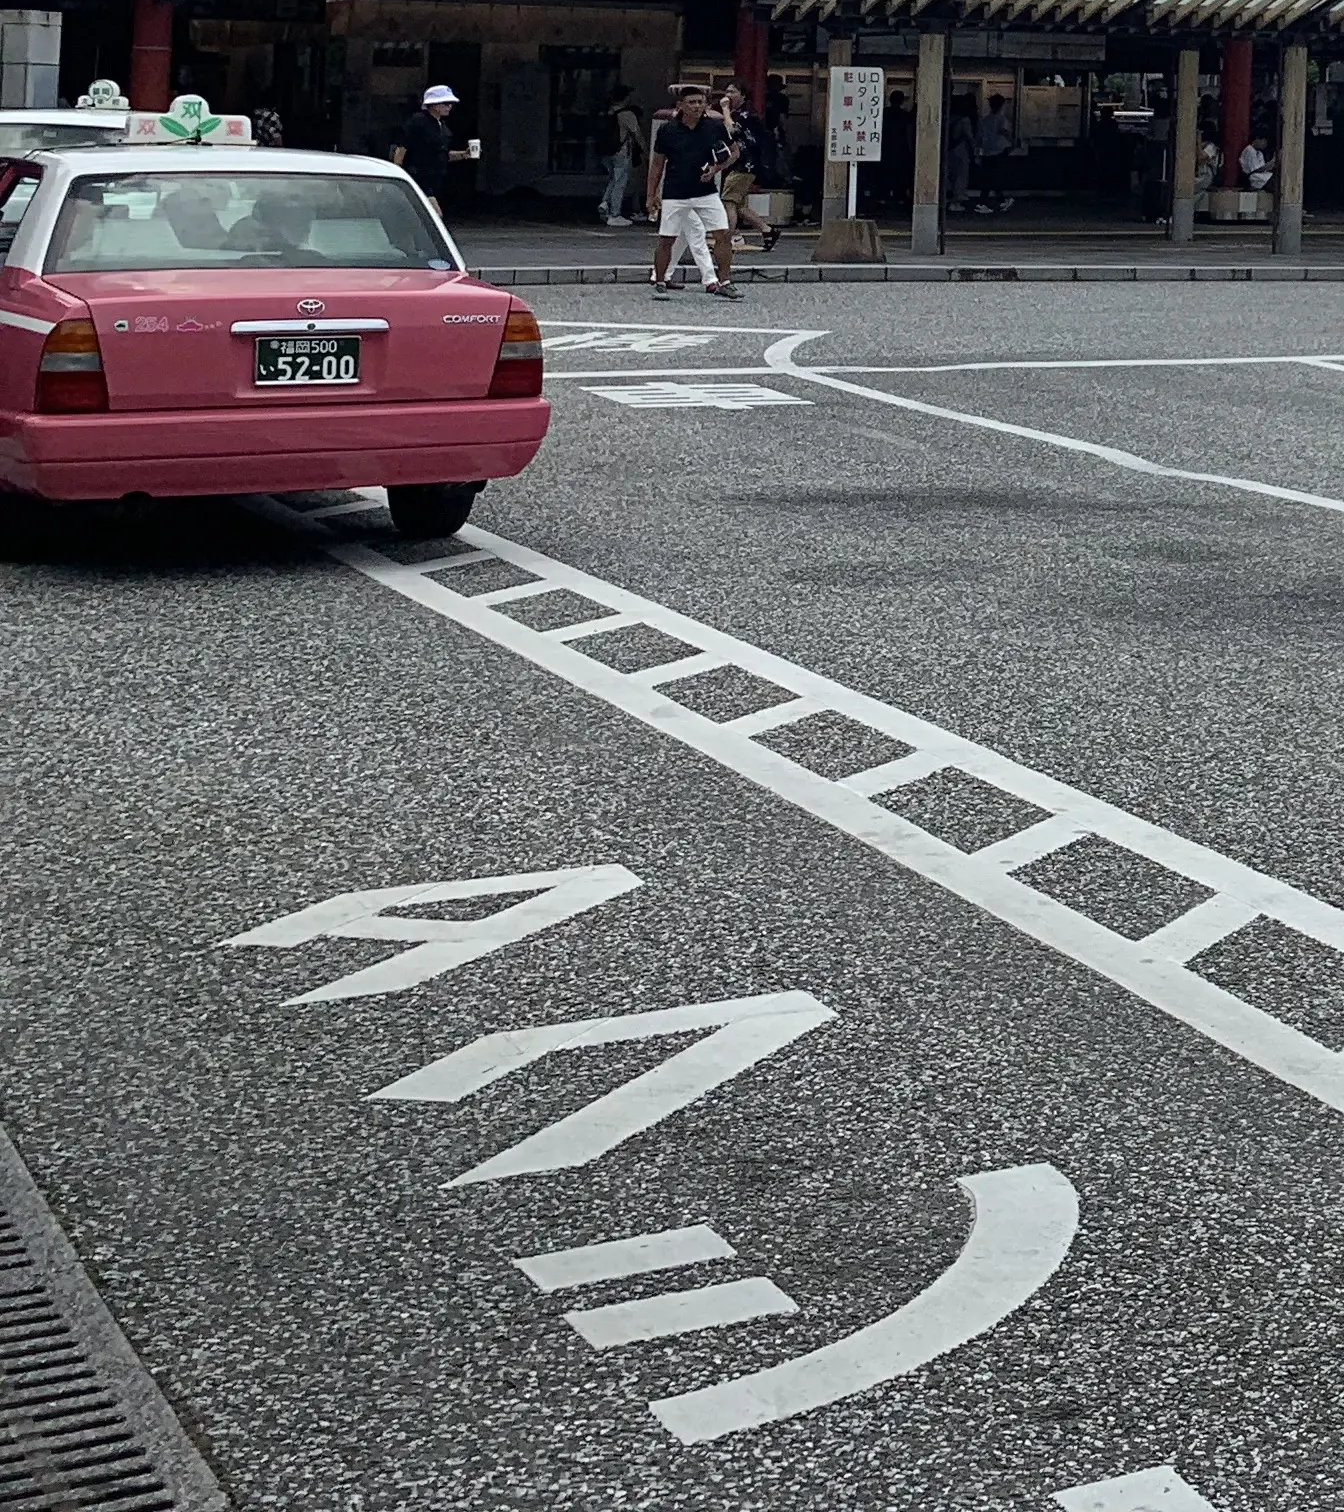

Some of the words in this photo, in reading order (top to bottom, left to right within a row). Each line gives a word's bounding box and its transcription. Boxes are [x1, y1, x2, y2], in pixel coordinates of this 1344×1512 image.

[856, 72, 867, 156] Uターン禁止
[869, 72, 880, 143] ロータリー内
[134, 316, 169, 332] 254
[443, 315, 501, 323] COMFORT
[260, 364, 275, 376] い
[277, 356, 355, 381] 52-00
[217, 863, 1220, 1512] タクシ
